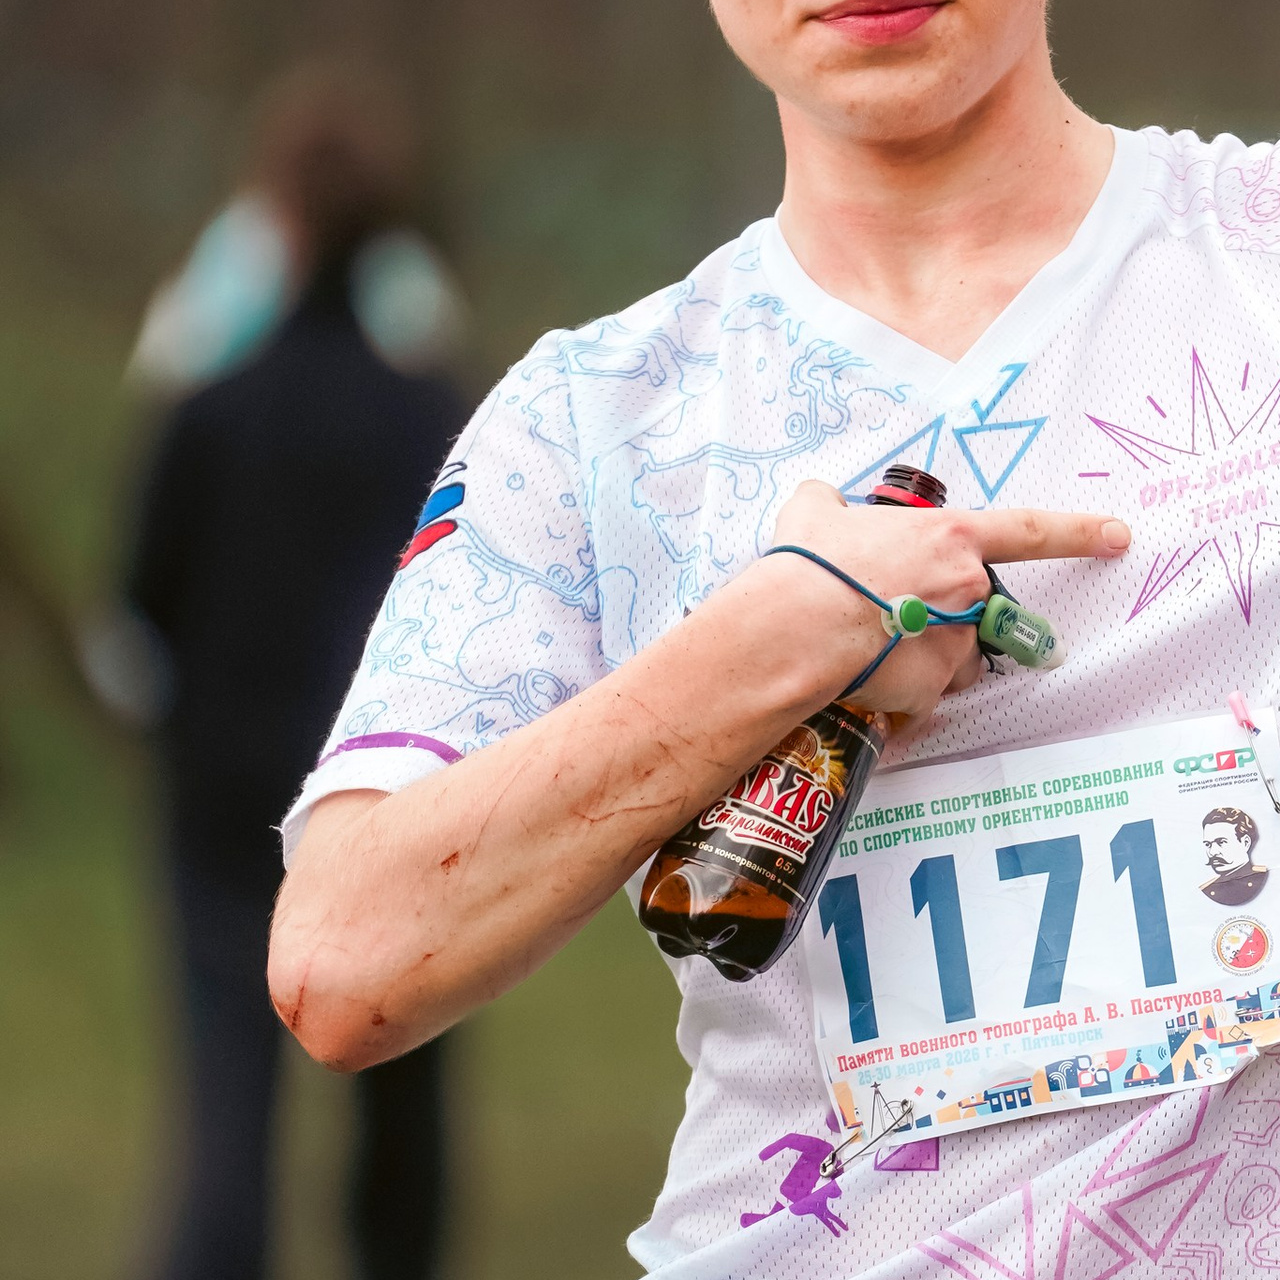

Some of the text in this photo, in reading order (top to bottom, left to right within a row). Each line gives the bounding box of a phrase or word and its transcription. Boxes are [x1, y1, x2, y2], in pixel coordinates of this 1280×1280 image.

[1188, 484, 1268, 528] TEAM
[930, 783, 1037, 815] СПОРТИВНЫЕ
[1042, 760, 1165, 796] СОРЕВНОВАНИЯ
[1178, 772, 1258, 788] ФЕДЕРАЦИЯ СПОРТИВНОГО
[1178, 781, 1233, 794] ОРИЕНТИРОВАНИЯ
[839, 790, 1129, 858] ПО СПОРТИВНОМУ ОРИЕНТИРОВАНИЮ
[698, 841, 776, 881] без консервантов
[775, 857, 796, 876] 0,5л
[817, 818, 1178, 1044] 1171
[836, 988, 1223, 1073] Памяти военного топографа А. В. Пастухова
[857, 1027, 1103, 1086] 25-30 марта 2026 г. г. Пятигорск
